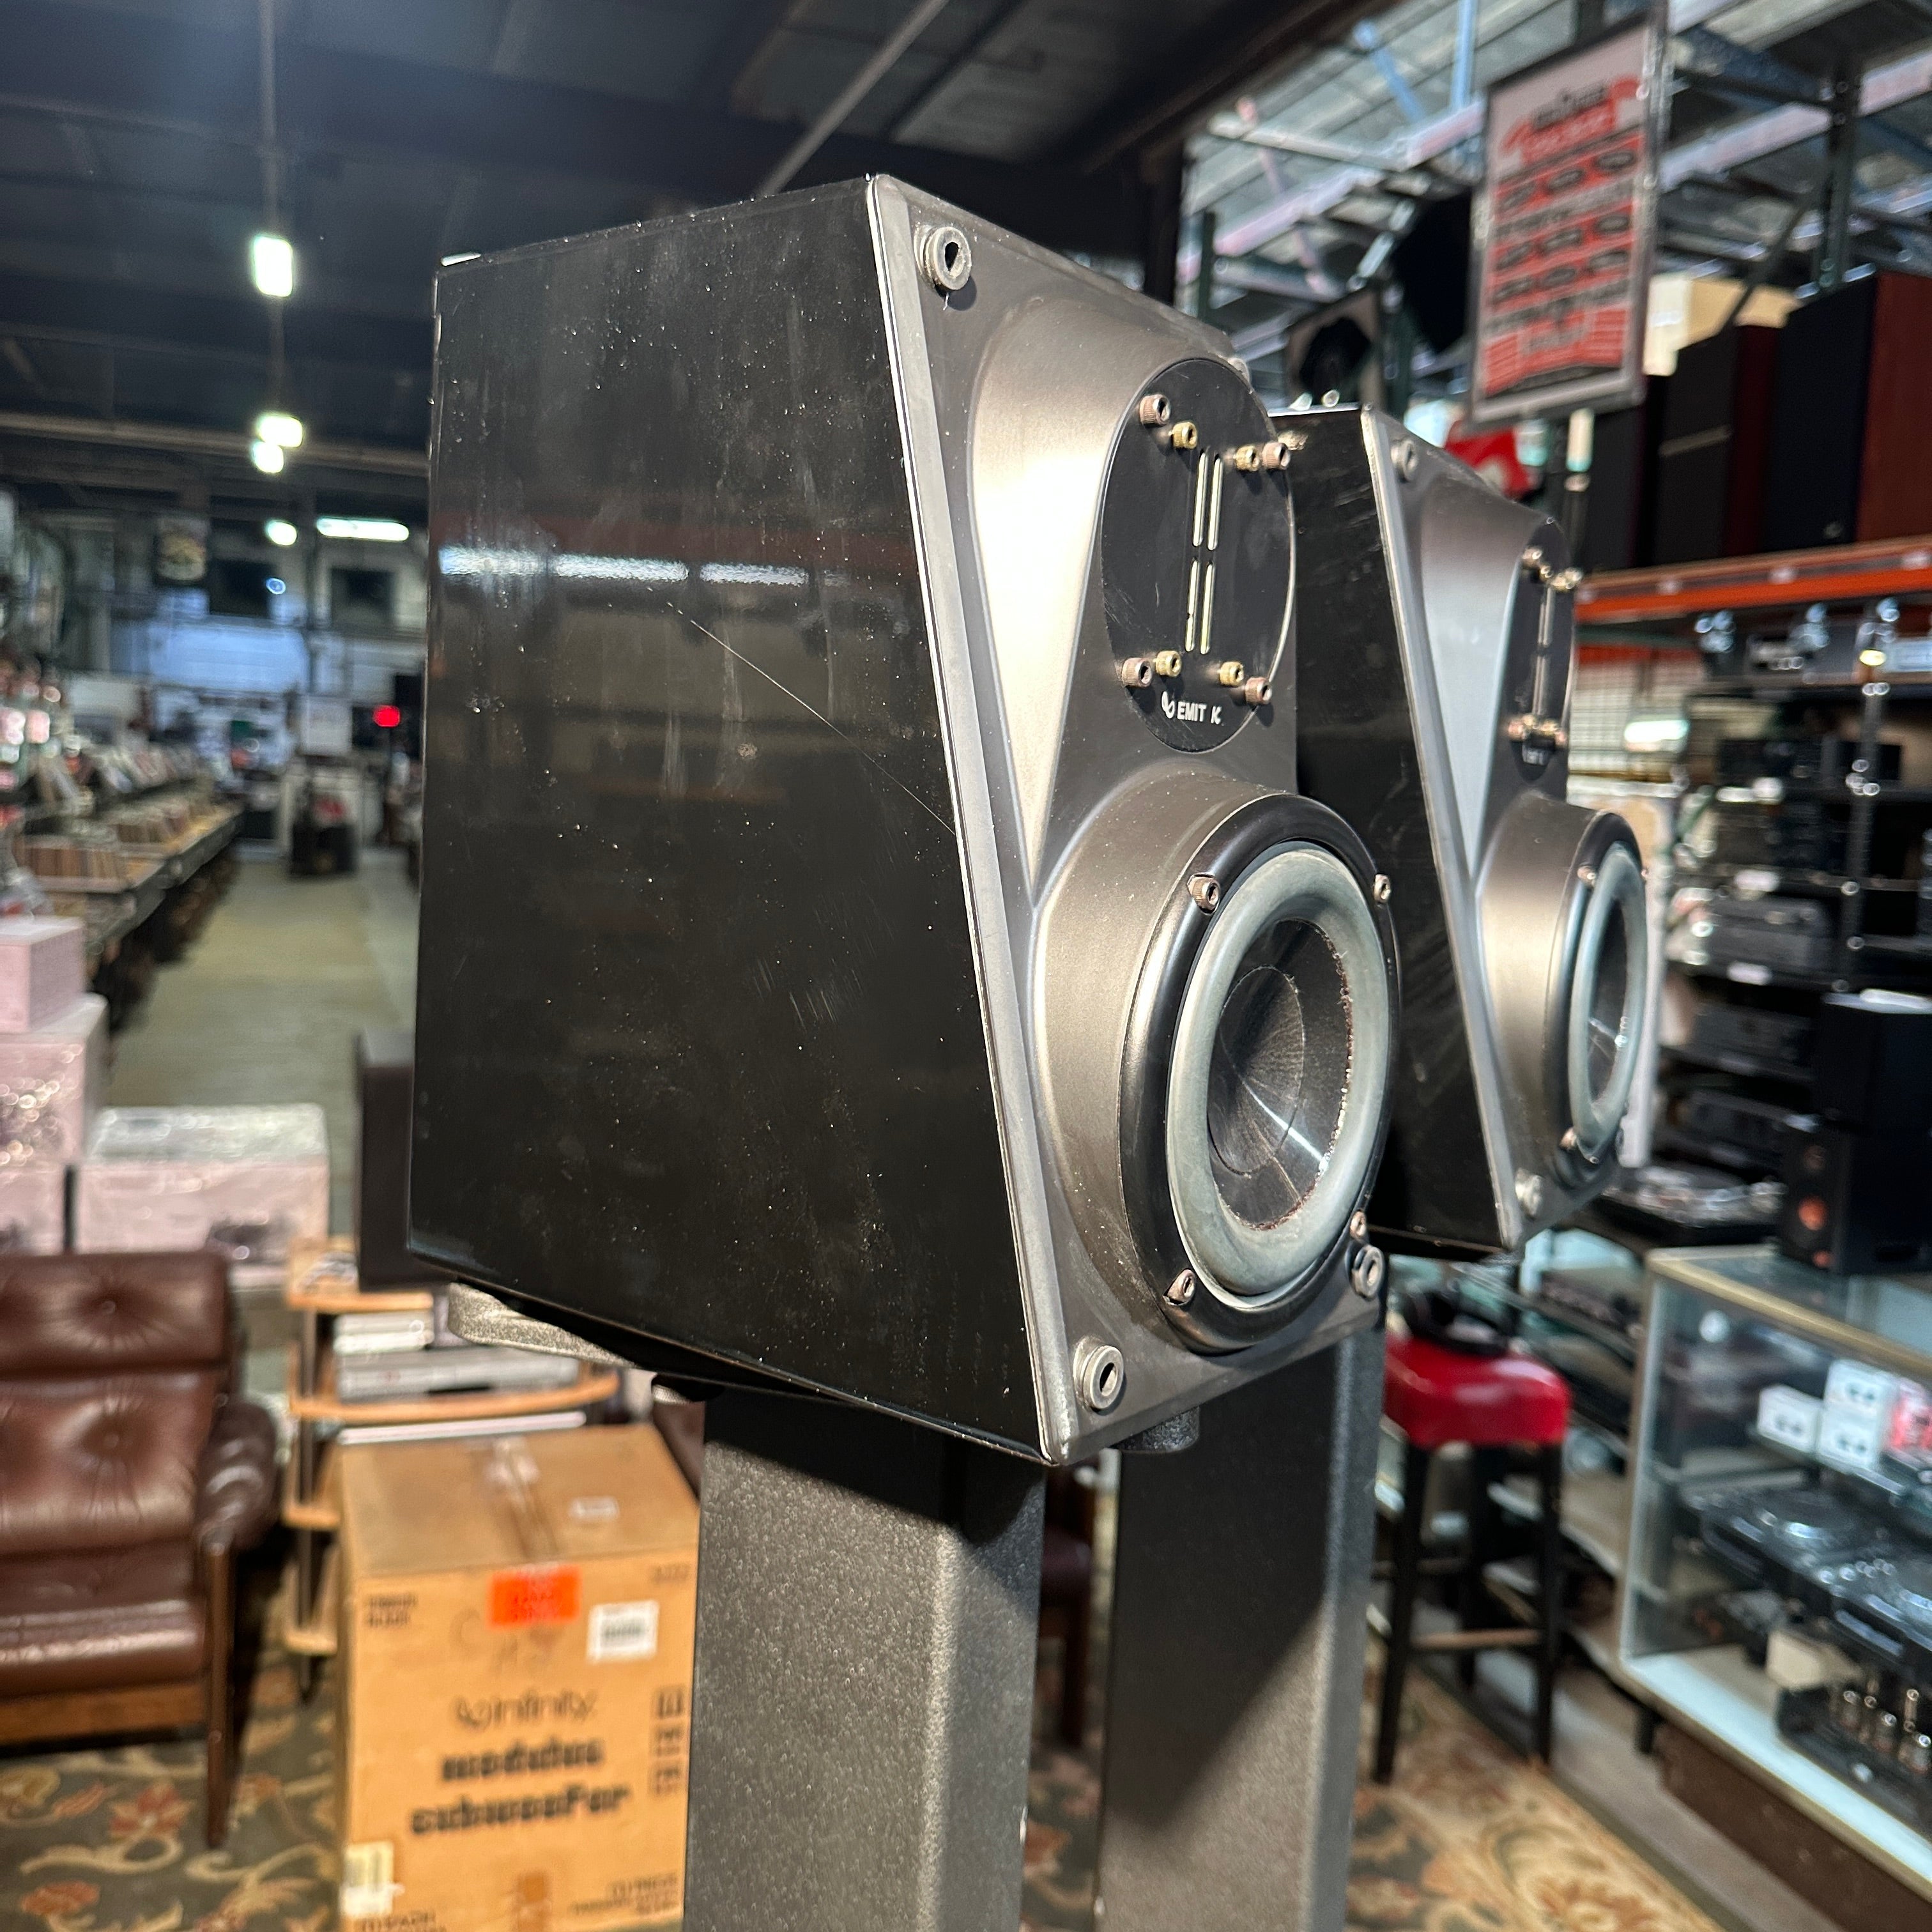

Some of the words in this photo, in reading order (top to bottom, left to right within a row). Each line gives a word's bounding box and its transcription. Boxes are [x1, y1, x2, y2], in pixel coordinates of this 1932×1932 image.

[1177, 701, 1208, 722] EMIT
[1211, 705, 1222, 724] K
[411, 1783, 629, 1834] subwoofer
